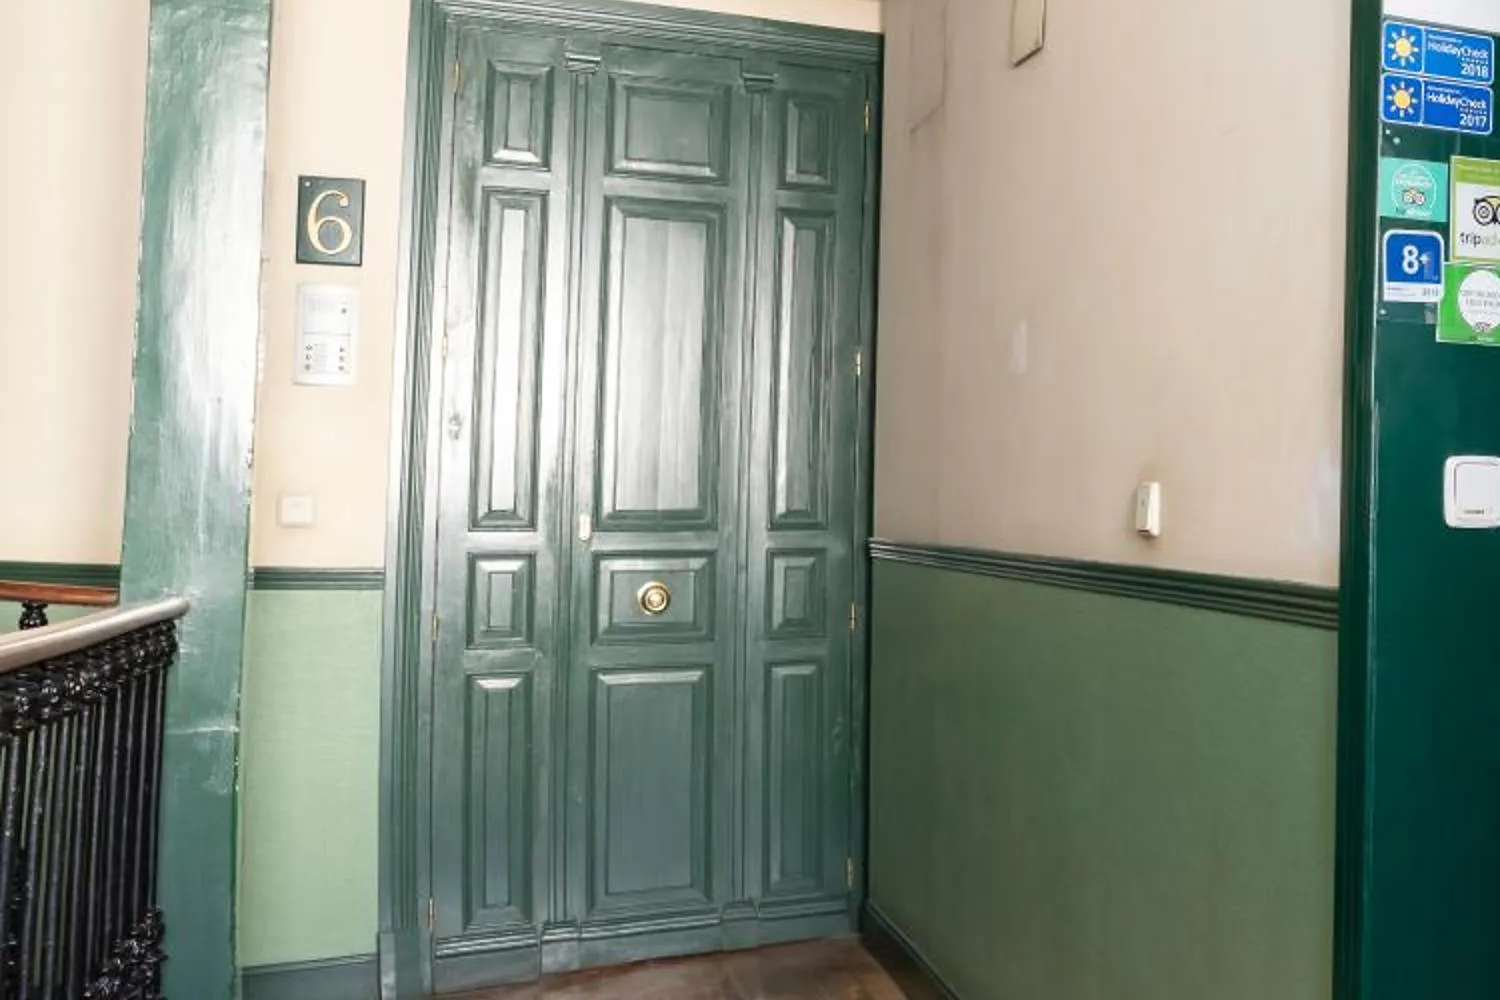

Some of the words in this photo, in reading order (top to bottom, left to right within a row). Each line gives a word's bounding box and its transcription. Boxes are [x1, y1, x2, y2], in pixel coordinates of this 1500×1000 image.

[1427, 42, 1488, 59] HolidayCheck
[1460, 64, 1489, 77] 2018
[1426, 93, 1487, 110] HolidayCheck
[1459, 113, 1487, 127] 2017
[307, 190, 353, 255] 6
